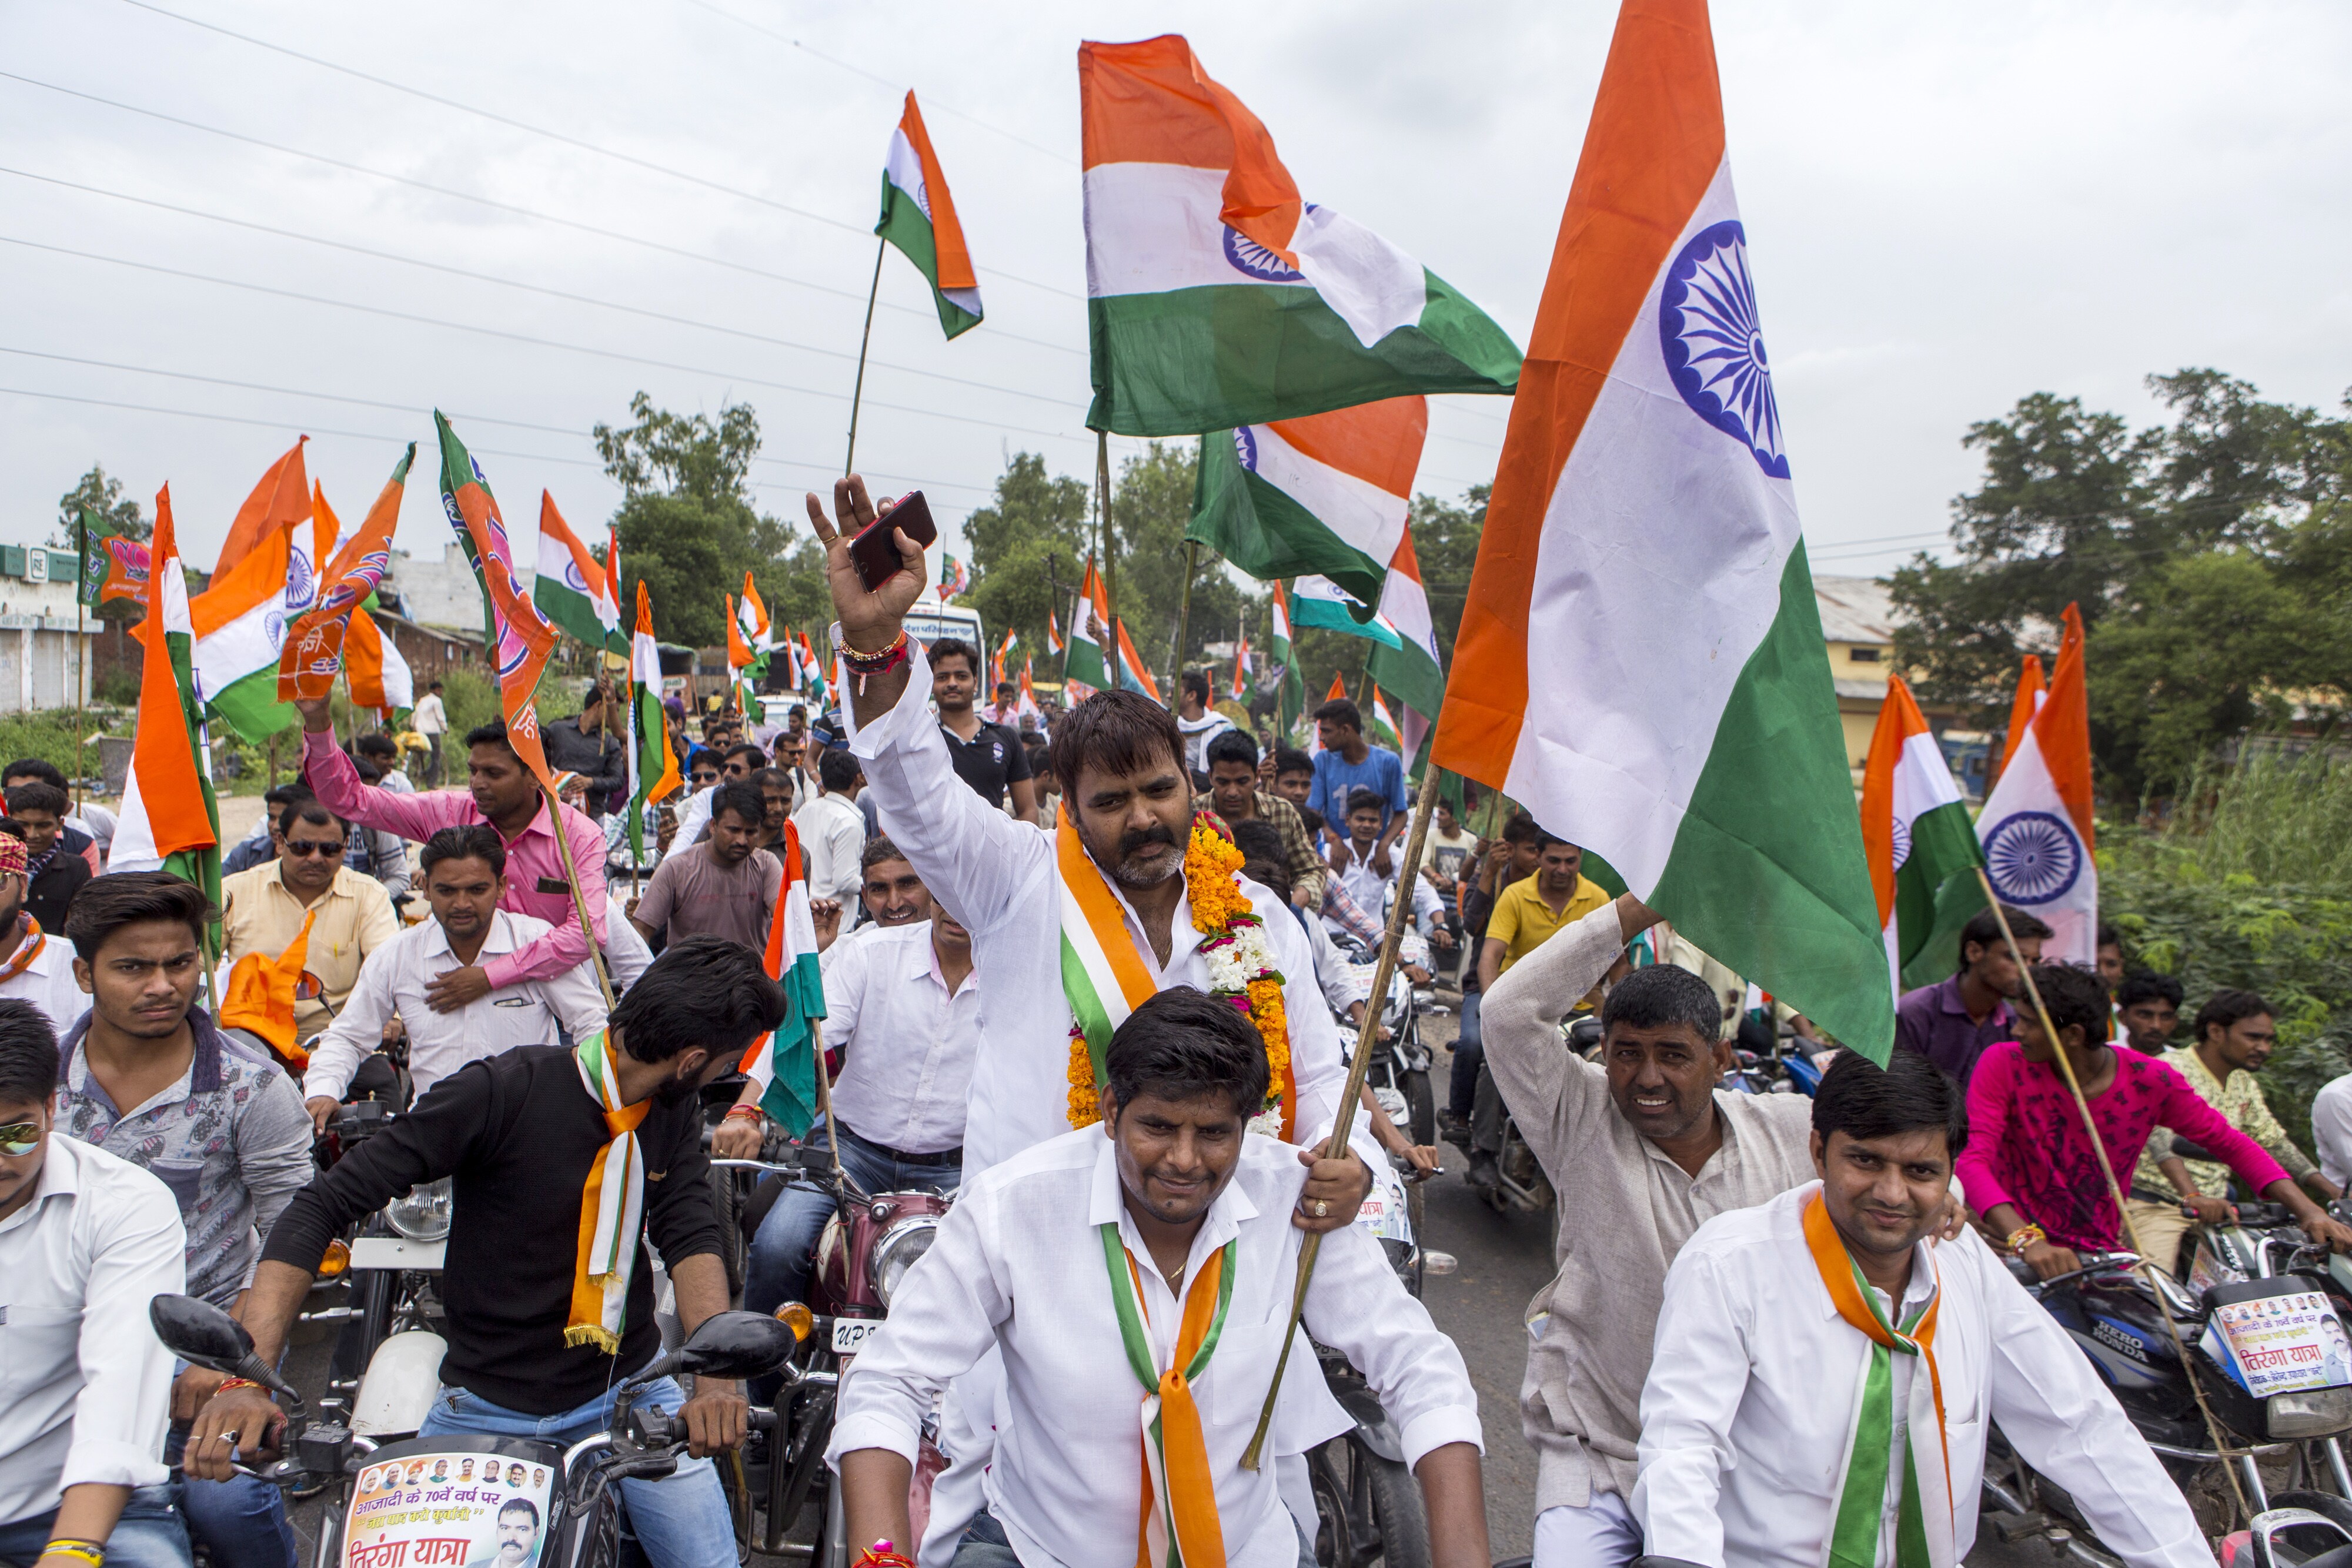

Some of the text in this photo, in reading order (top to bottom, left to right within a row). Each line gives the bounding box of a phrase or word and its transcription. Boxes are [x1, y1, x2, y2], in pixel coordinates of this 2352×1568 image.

[2098, 1320, 2144, 1349] HERO
[2229, 1320, 2261, 1335] आजादी
[2263, 1319, 2273, 1328] के
[2291, 1313, 2304, 1323] वर्ष
[2305, 1314, 2317, 1322] पर
[2092, 1326, 2150, 1363] HONDA
[2239, 1344, 2323, 1372] तिरंगा यात्रा
[1332, 1371, 1370, 1407] 1
[355, 1486, 502, 1515] आजादी के 70वें वर्ष पर
[366, 1517, 384, 1530] जरा
[386, 1512, 407, 1526] याद
[409, 1507, 430, 1523] करो
[432, 1506, 471, 1524] कुर्बानी
[349, 1532, 471, 1568] तिरंगा यात्रा
